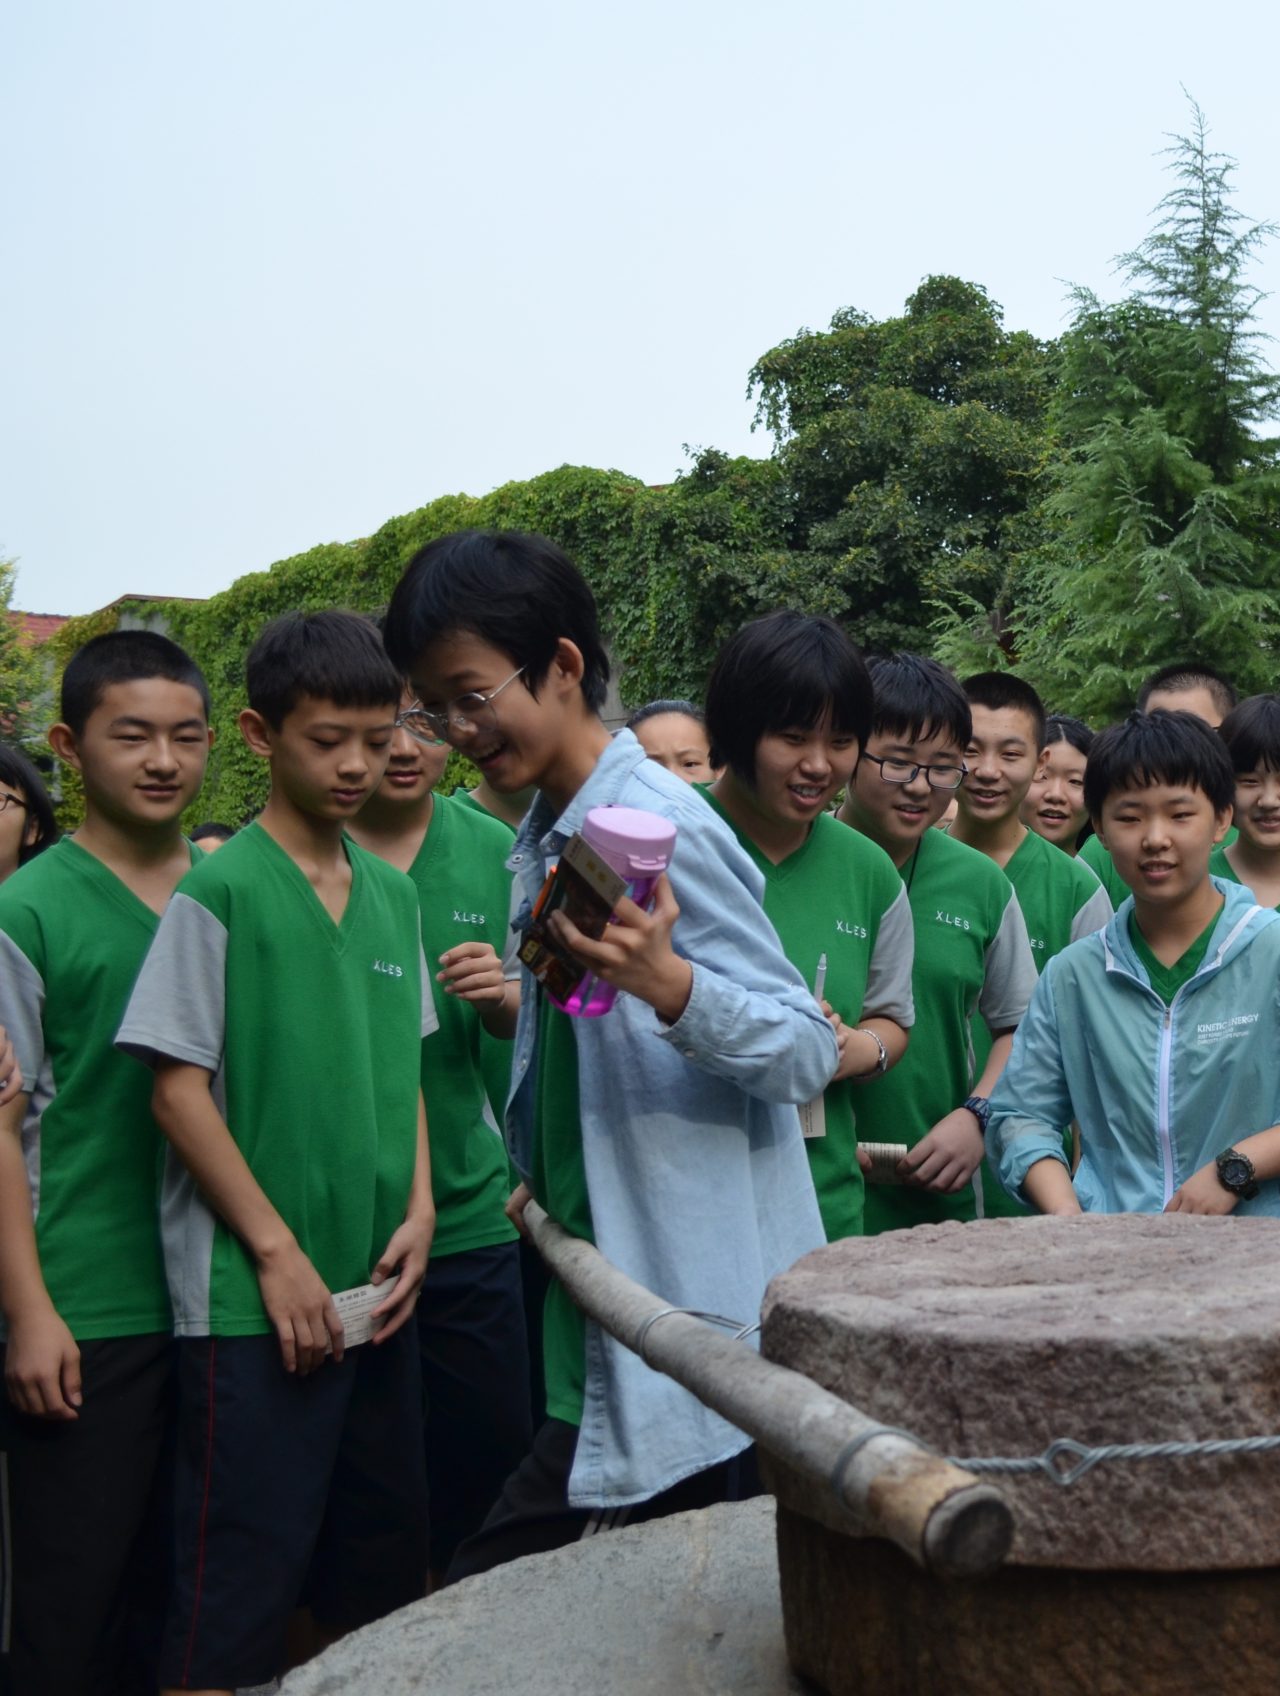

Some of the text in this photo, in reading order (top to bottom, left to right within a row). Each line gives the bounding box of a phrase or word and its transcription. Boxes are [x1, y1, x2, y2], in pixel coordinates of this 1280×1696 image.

[453, 910, 485, 924] XLES
[935, 910, 970, 930] XLES
[836, 920, 867, 938] XLES
[1030, 938, 1045, 949] ES
[373, 959, 403, 977] XLES
[1197, 1021, 1228, 1033] KINETIC
